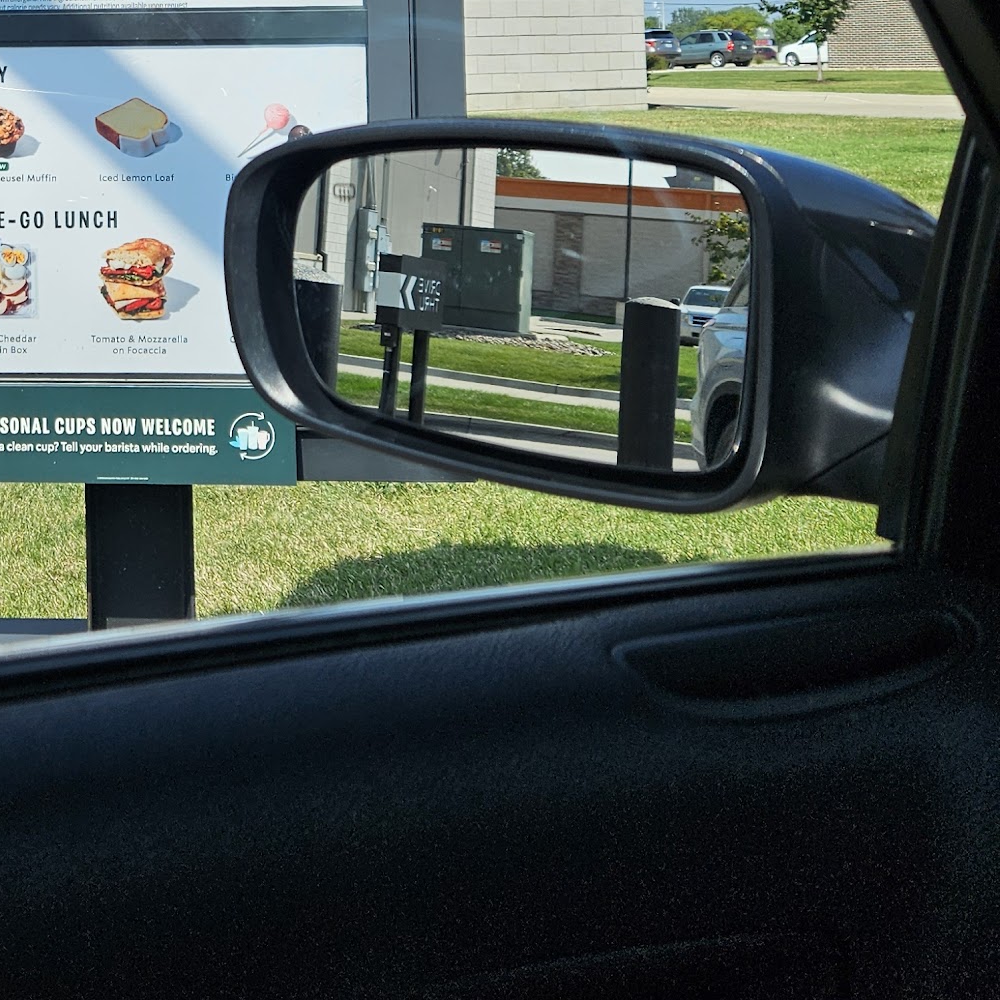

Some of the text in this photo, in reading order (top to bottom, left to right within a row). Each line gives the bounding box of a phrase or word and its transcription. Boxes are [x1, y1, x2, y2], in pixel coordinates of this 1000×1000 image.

[27, 174, 57, 182] Muffin
[99, 173, 175, 182] Iced Lemon Loaf
[54, 210, 118, 229] LUNCH
[91, 335, 188, 344] Tomato & Mozzarella
[10, 346, 28, 354] Box
[112, 346, 167, 355] on Focaccia
[54, 417, 96, 435] CUPS
[101, 417, 136, 435] NOW
[141, 418, 215, 436] WELCOME
[6, 441, 34, 452] clean
[35, 441, 59, 454] cup?
[60, 441, 78, 452] Tell
[79, 443, 103, 454] your
[104, 442, 140, 453] barista
[141, 442, 170, 453] while
[171, 442, 218, 456] ordering.
